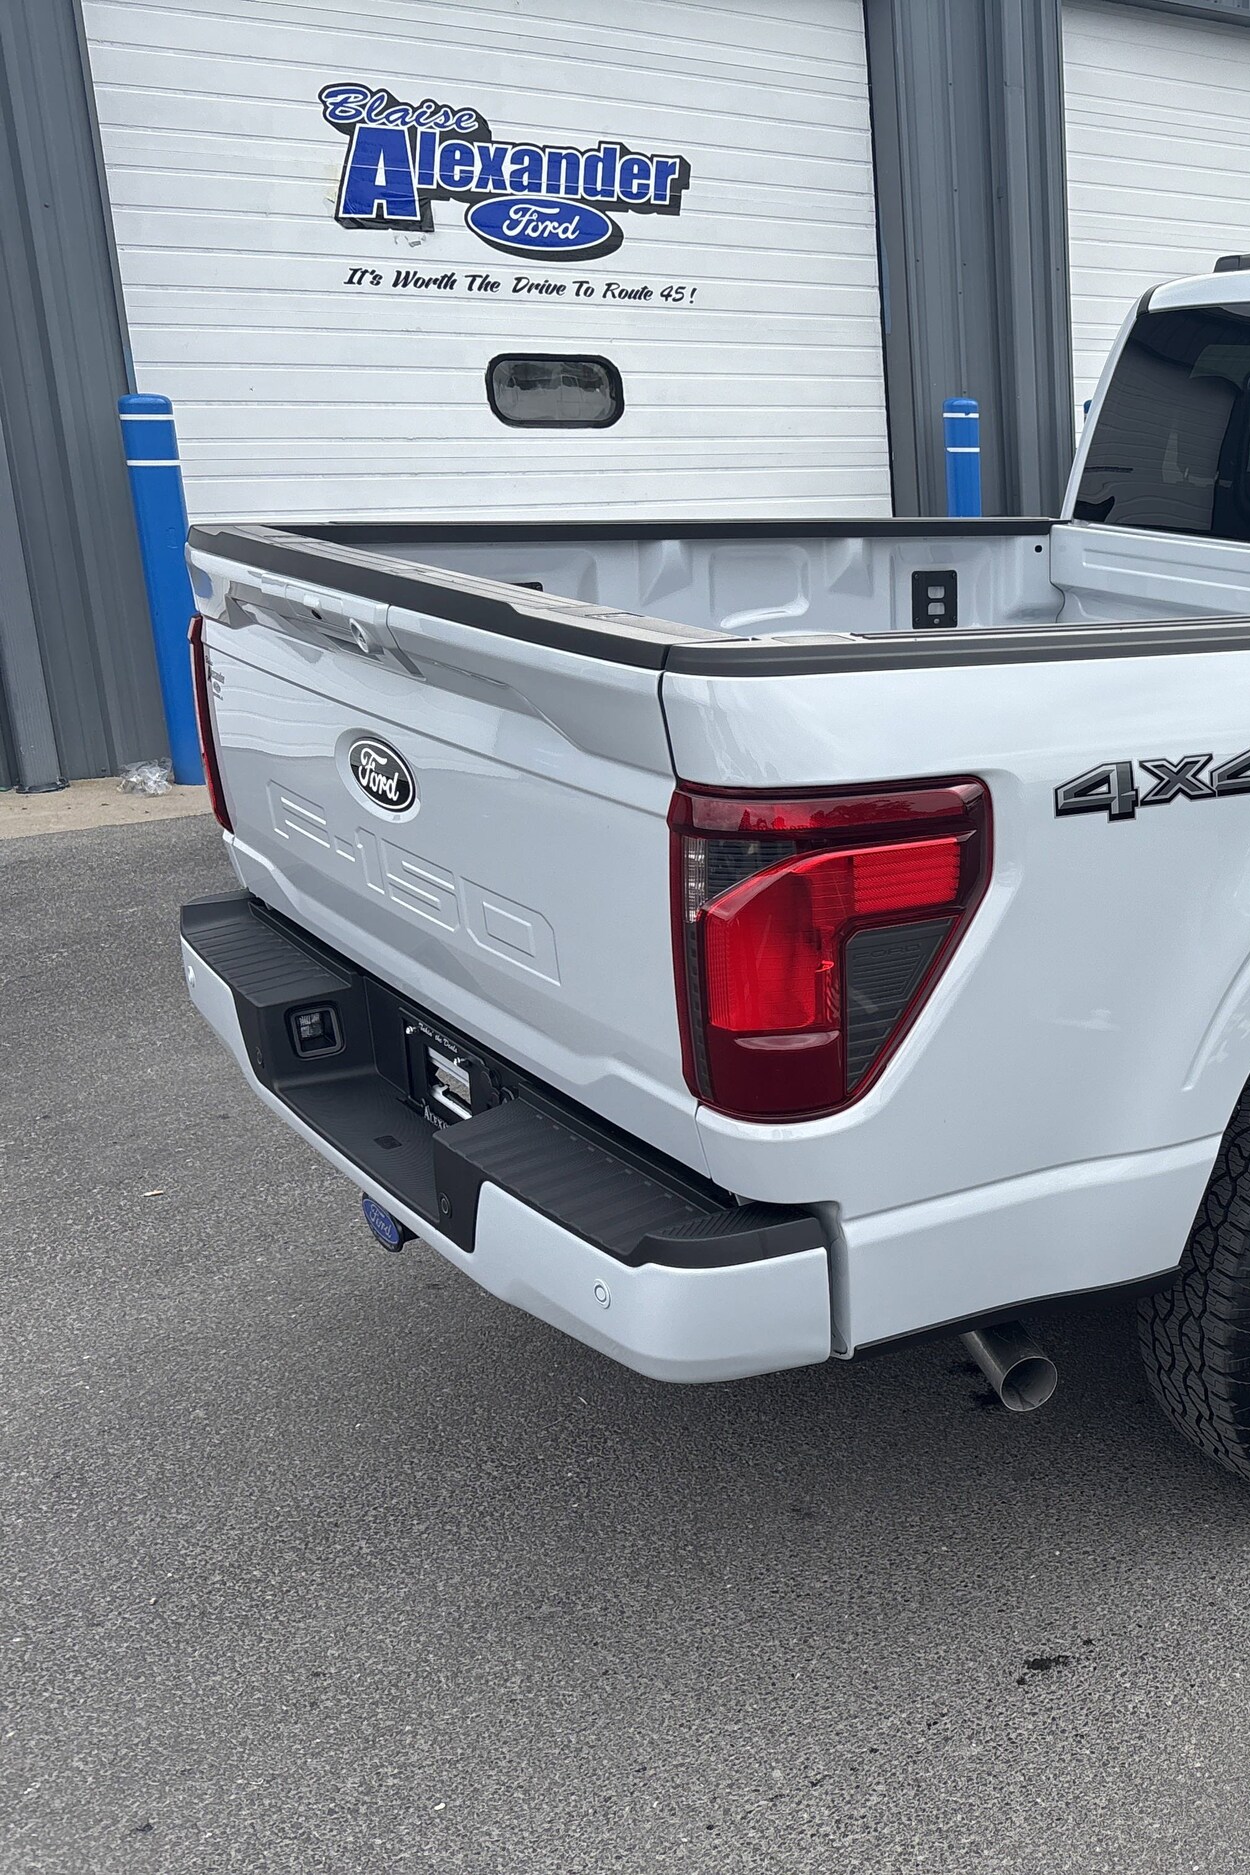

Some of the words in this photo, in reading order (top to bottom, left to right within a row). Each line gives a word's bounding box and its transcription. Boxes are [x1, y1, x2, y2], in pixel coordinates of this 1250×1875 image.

[321, 86, 480, 133] Blaise
[338, 123, 680, 221] Alexander
[501, 204, 581, 241] Ford
[343, 266, 383, 287] It's
[392, 270, 457, 292] Worth
[464, 274, 501, 294] The
[513, 276, 567, 297] Drive
[573, 280, 596, 299] To
[601, 282, 653, 302] Route
[357, 747, 400, 802] Ford
[266, 779, 562, 986] F-150
[370, 1204, 392, 1238] Ford
